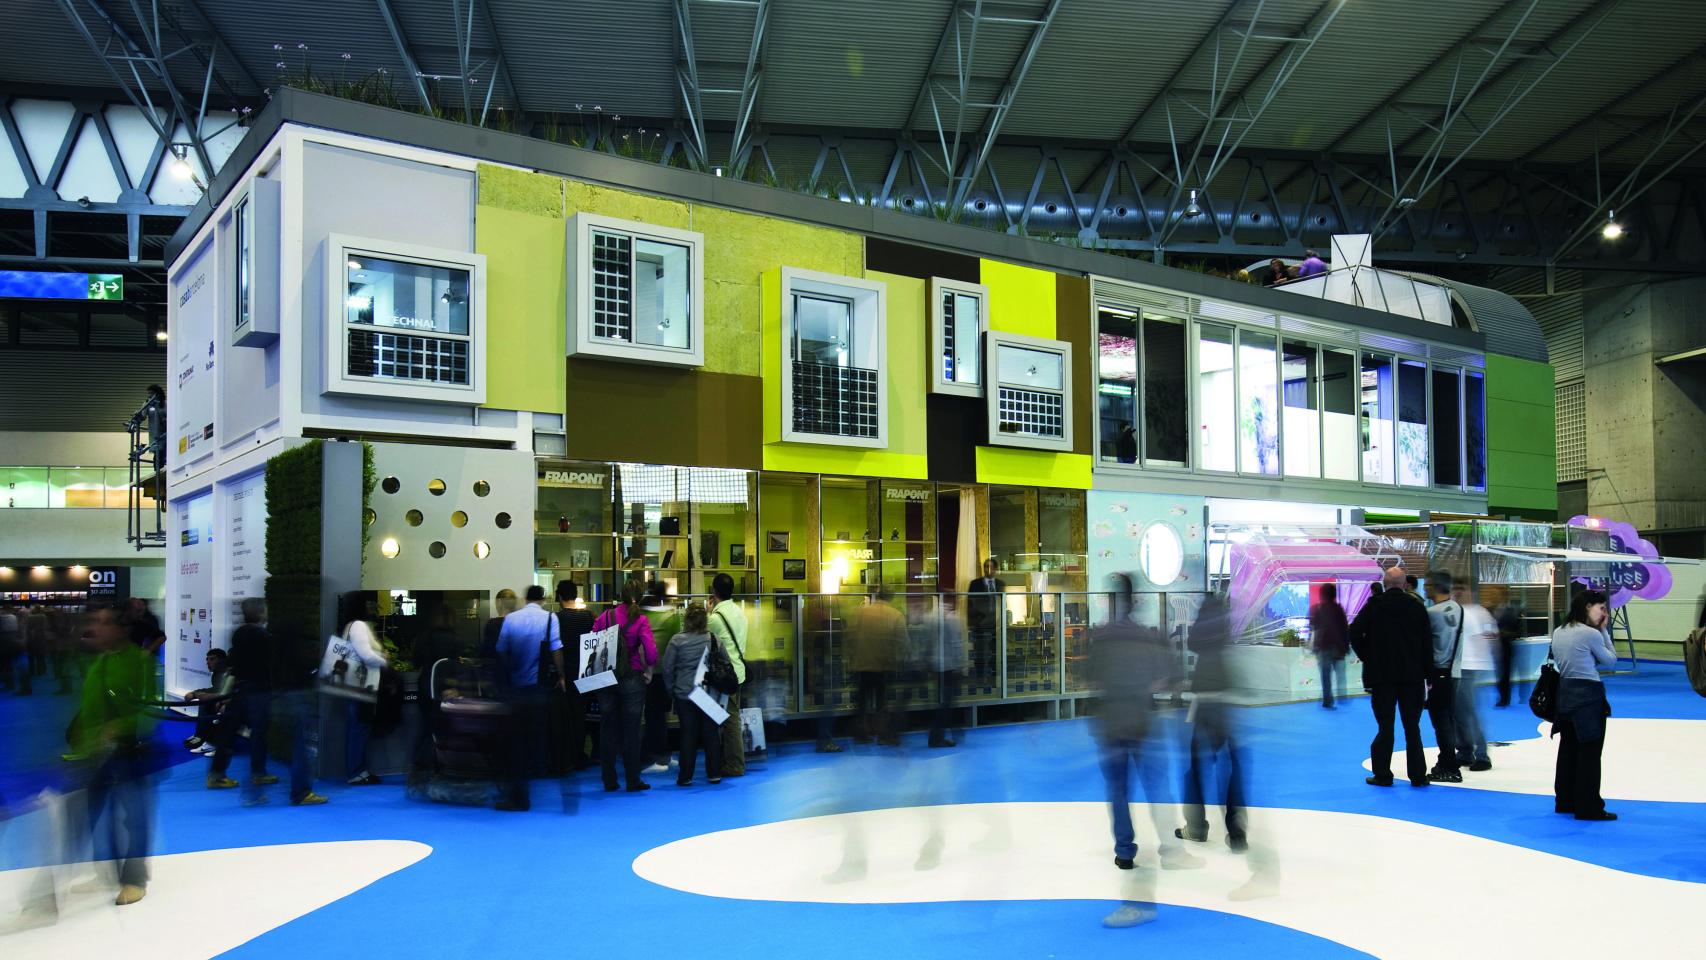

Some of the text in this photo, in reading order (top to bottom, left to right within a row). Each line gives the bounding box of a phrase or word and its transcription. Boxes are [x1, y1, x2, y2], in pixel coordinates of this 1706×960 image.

[388, 316, 437, 329] ECHNAL
[544, 470, 605, 485] FRAPONT
[887, 488, 930, 500] FRAPONT
[89, 570, 116, 583] on
